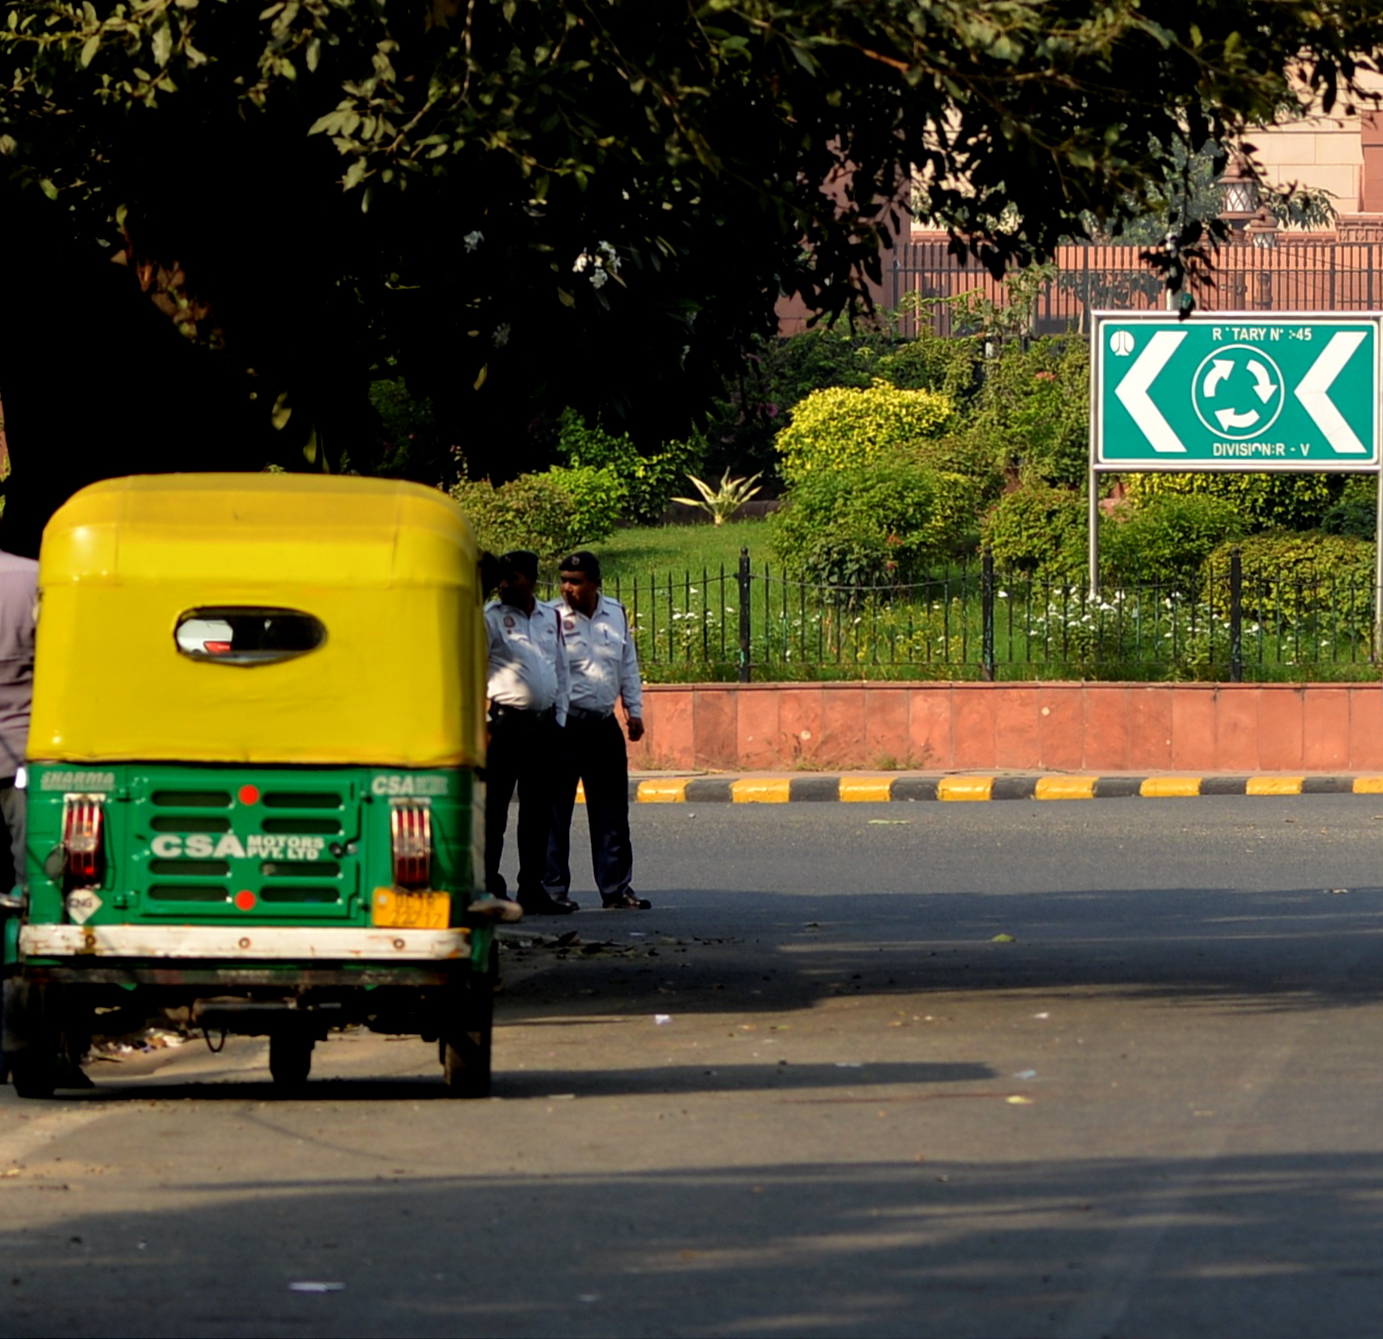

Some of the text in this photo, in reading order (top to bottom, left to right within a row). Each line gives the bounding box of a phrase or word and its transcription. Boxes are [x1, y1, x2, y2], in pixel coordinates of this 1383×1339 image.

[1212, 327, 1267, 341] RTARY
[372, 775, 414, 795] CSA
[151, 834, 246, 858] CSA
[247, 835, 325, 849] MOTORS
[287, 848, 319, 860] LTD
